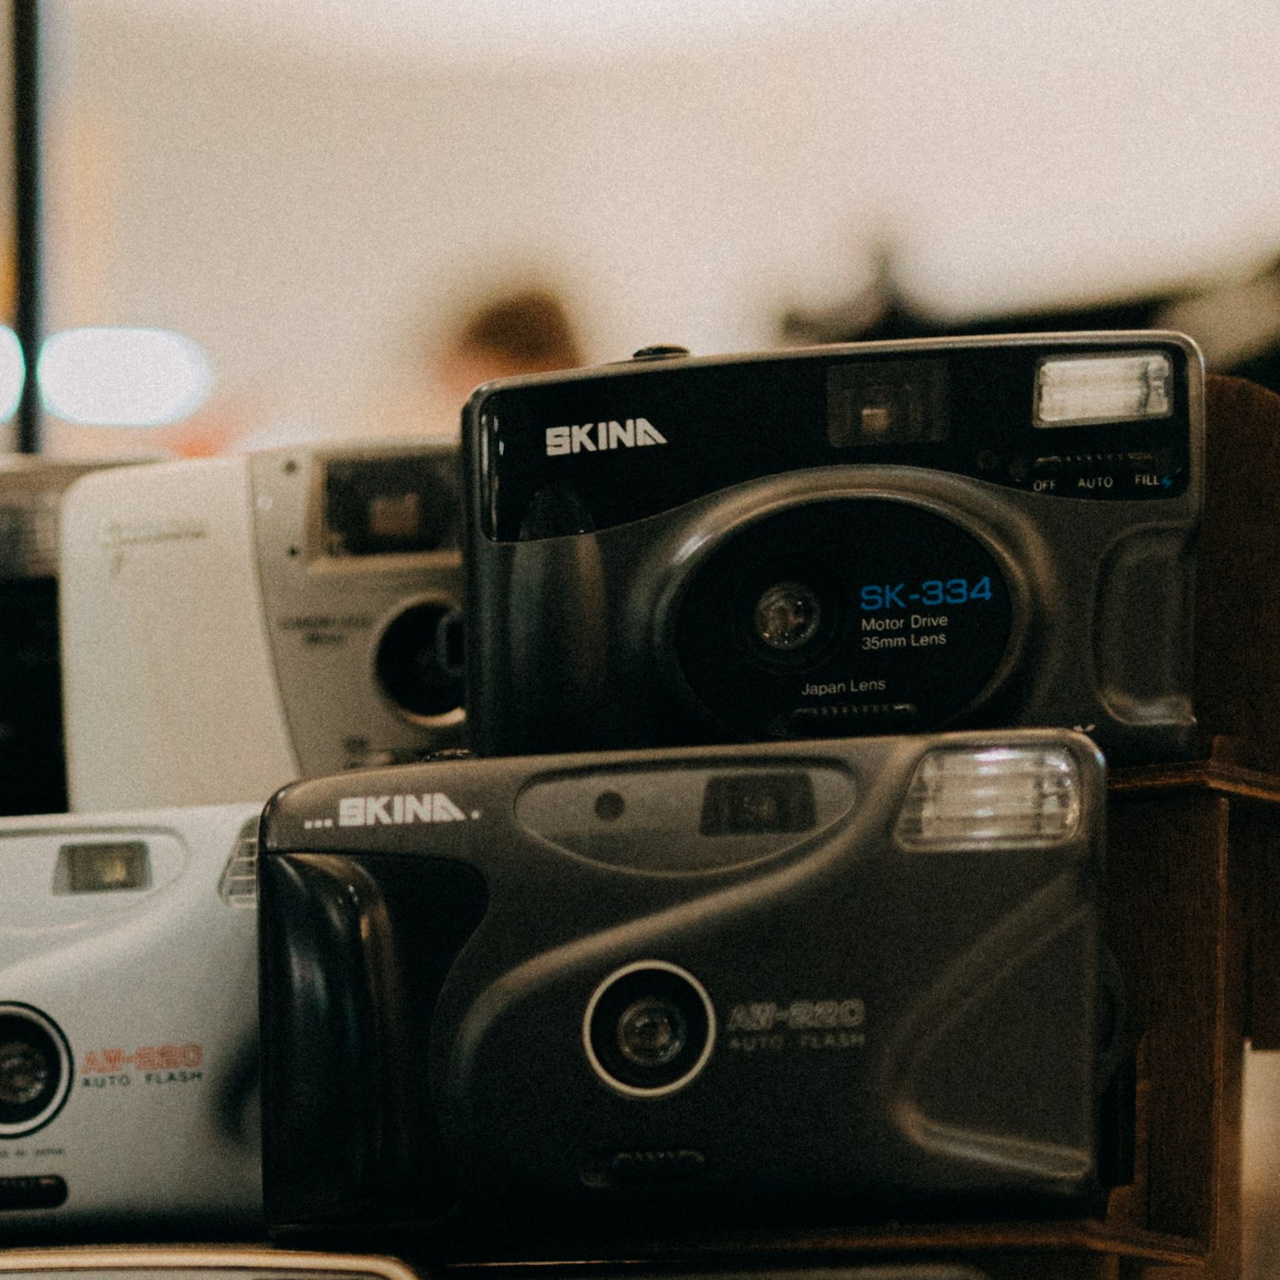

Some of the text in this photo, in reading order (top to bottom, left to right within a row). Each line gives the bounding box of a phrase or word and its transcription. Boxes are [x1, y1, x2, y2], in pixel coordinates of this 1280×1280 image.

[545, 417, 667, 457] SKINA
[1033, 474, 1160, 492] OFF AUTO FILL
[860, 576, 992, 611] SK-334
[861, 614, 949, 631] Motor Drive
[862, 633, 947, 650] 35mm Lens
[801, 679, 886, 697] Japan Lens
[82, 1071, 203, 1089] AUTO FLASH
